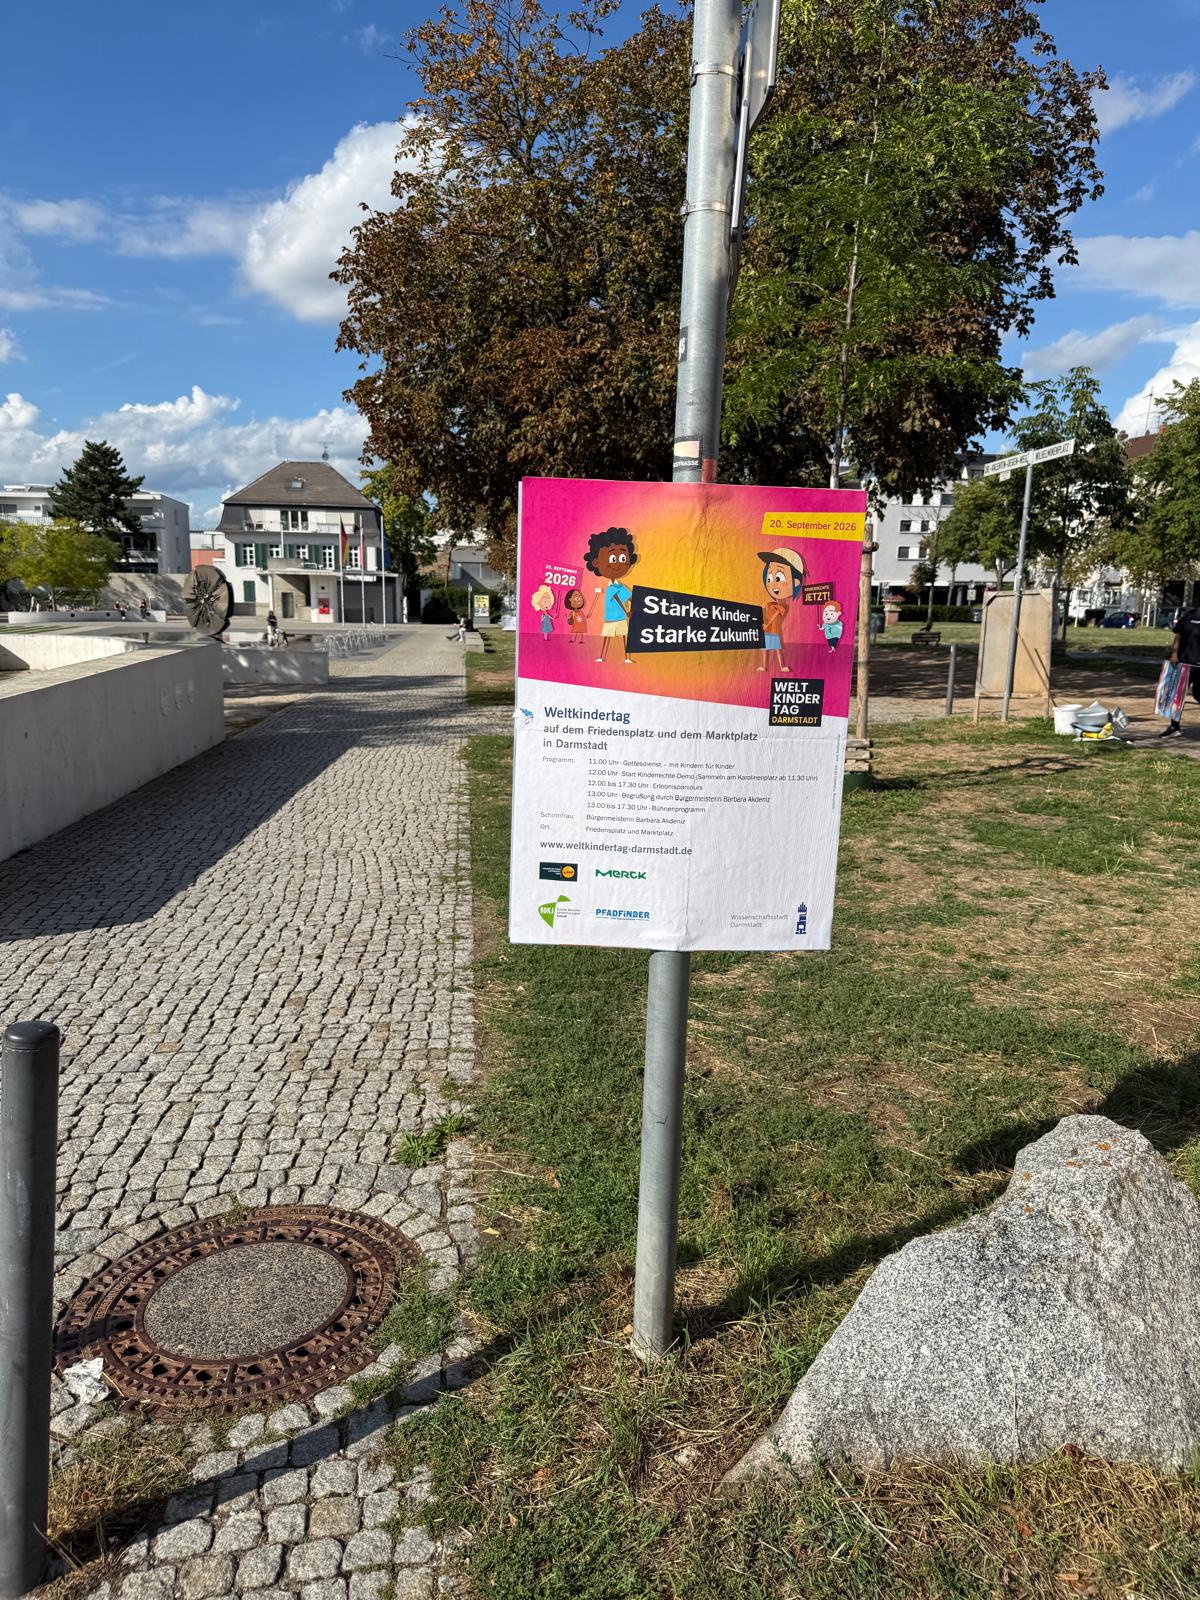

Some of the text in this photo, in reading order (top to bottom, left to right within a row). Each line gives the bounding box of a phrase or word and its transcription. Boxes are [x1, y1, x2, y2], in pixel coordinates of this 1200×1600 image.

[770, 519, 857, 532] 20. September 2026
[544, 571, 576, 587] 2026
[803, 591, 831, 602] JETZT!
[642, 595, 709, 619] Starke
[711, 605, 751, 623] Kinder
[640, 624, 760, 644] starke Zukunft!
[774, 681, 809, 694] WELT
[773, 692, 821, 705] KINDER
[544, 706, 631, 725] Weltkindertag
[772, 703, 800, 715] TAG
[771, 715, 819, 725] DARMSTADT
[543, 724, 759, 743] auf dem Friedensplatz und dem Marktplatz
[543, 738, 608, 751] in Darmstadt
[623, 760, 662, 768] Gottesdienst
[652, 783, 703, 791] Erlebnisparcours
[621, 792, 655, 801] Begrüßung
[674, 794, 723, 802] Bürgermeisterin
[723, 795, 747, 803] Barbara
[651, 805, 706, 813] Bühnenprogramm
[586, 814, 635, 823] Bürgermeisterin
[635, 816, 660, 824] Barbara
[661, 817, 686, 825] Akdeniz
[585, 826, 626, 835] Friedensplatz
[640, 829, 674, 837] Marktplatz
[540, 841, 693, 856] www.weltkindertag-darmstadt.de
